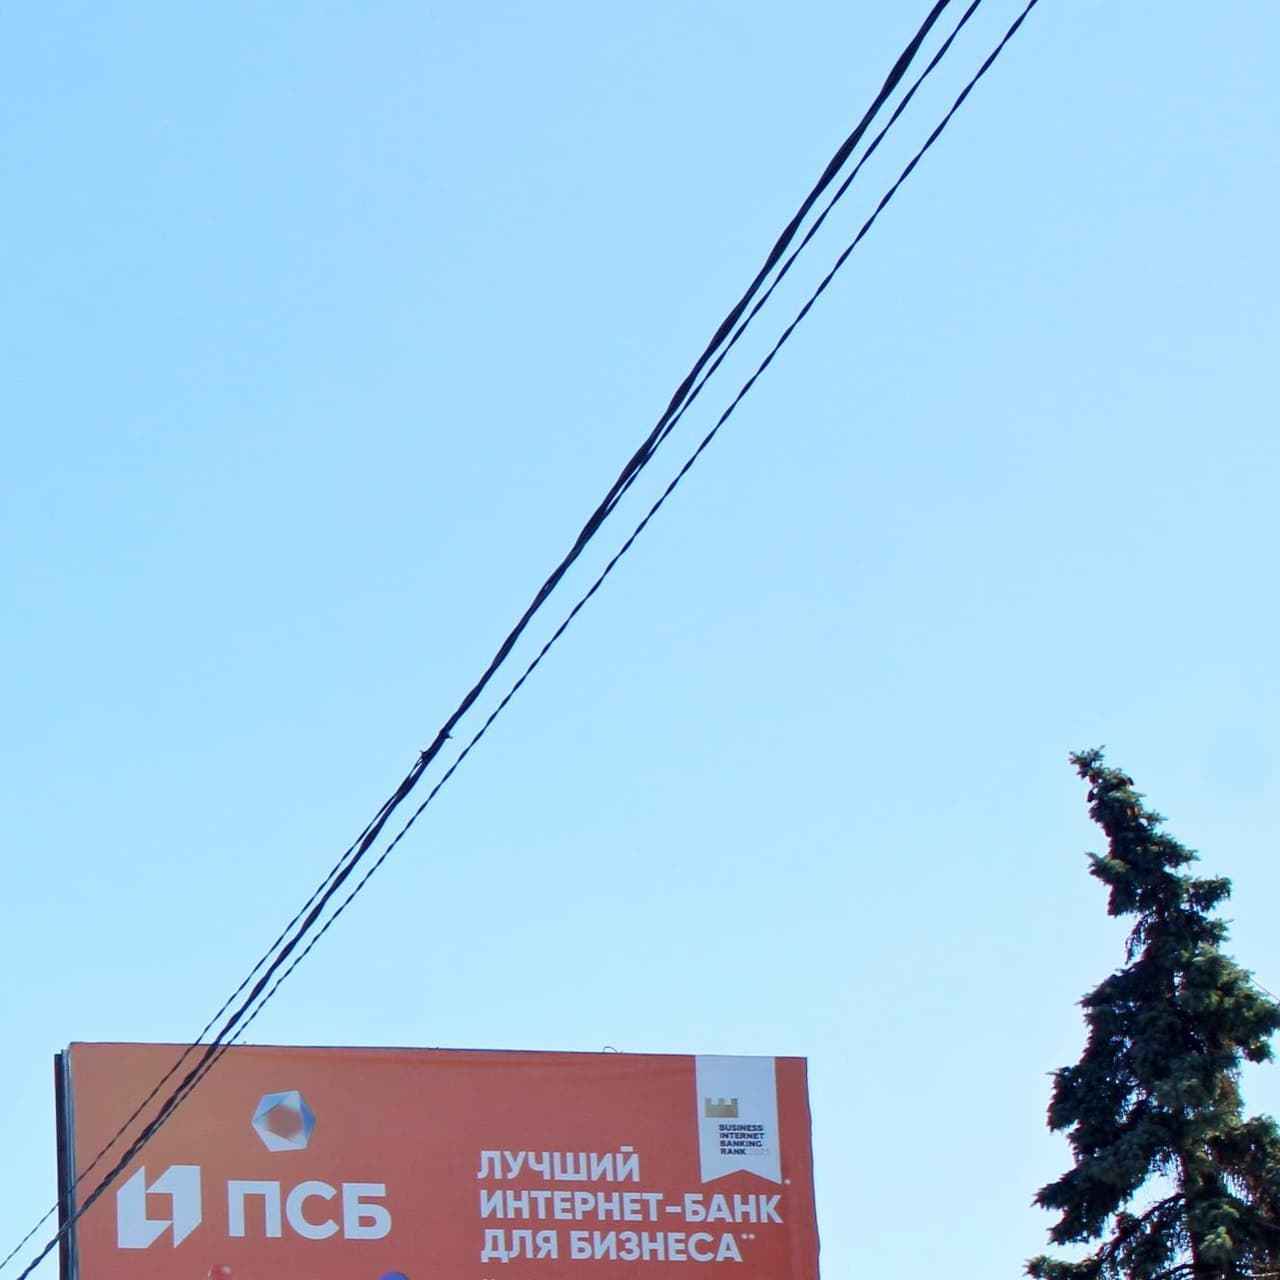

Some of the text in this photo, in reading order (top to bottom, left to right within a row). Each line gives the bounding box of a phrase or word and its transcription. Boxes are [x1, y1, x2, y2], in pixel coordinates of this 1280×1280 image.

[477, 1146, 640, 1182] ЛУЧШИЙ
[227, 1180, 392, 1240] ПСБ
[480, 1189, 784, 1224] ИНТЕРНЕТ-БАНК
[481, 1229, 558, 1263] ДЛЯ
